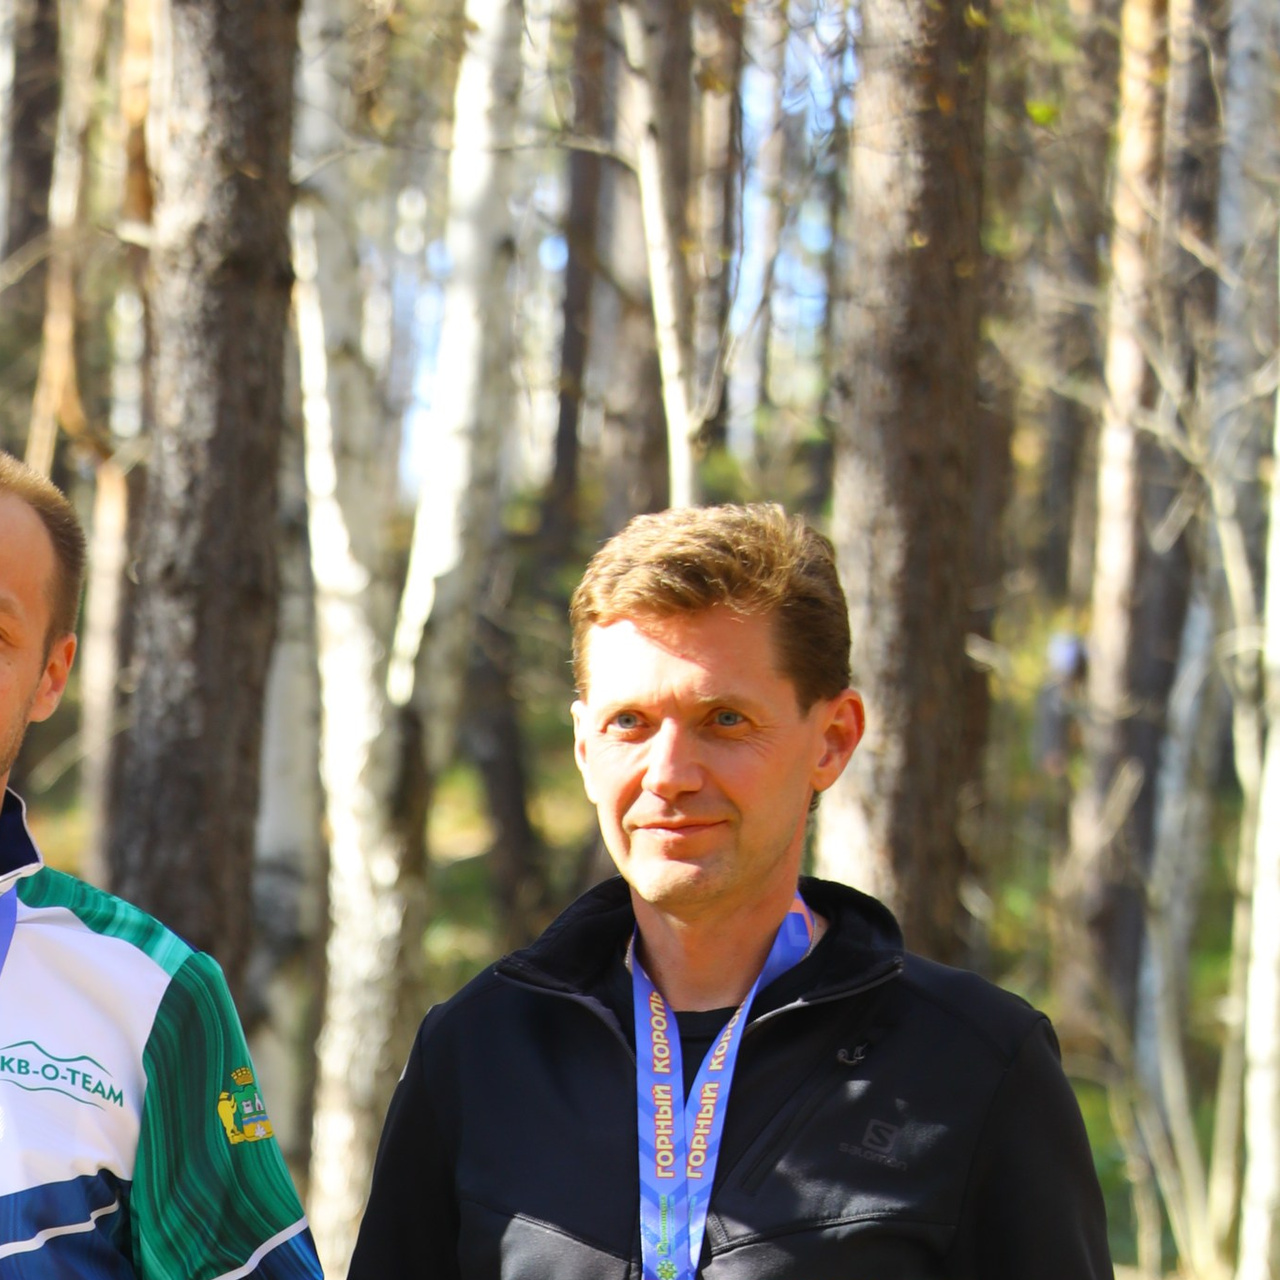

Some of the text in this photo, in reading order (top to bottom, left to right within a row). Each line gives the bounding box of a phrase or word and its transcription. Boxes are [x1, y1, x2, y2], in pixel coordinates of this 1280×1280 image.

[650, 991, 675, 1179] ГОРНЫЙ КОРОЛЬ
[686, 1082, 719, 1179] ГОРНЫЙ
